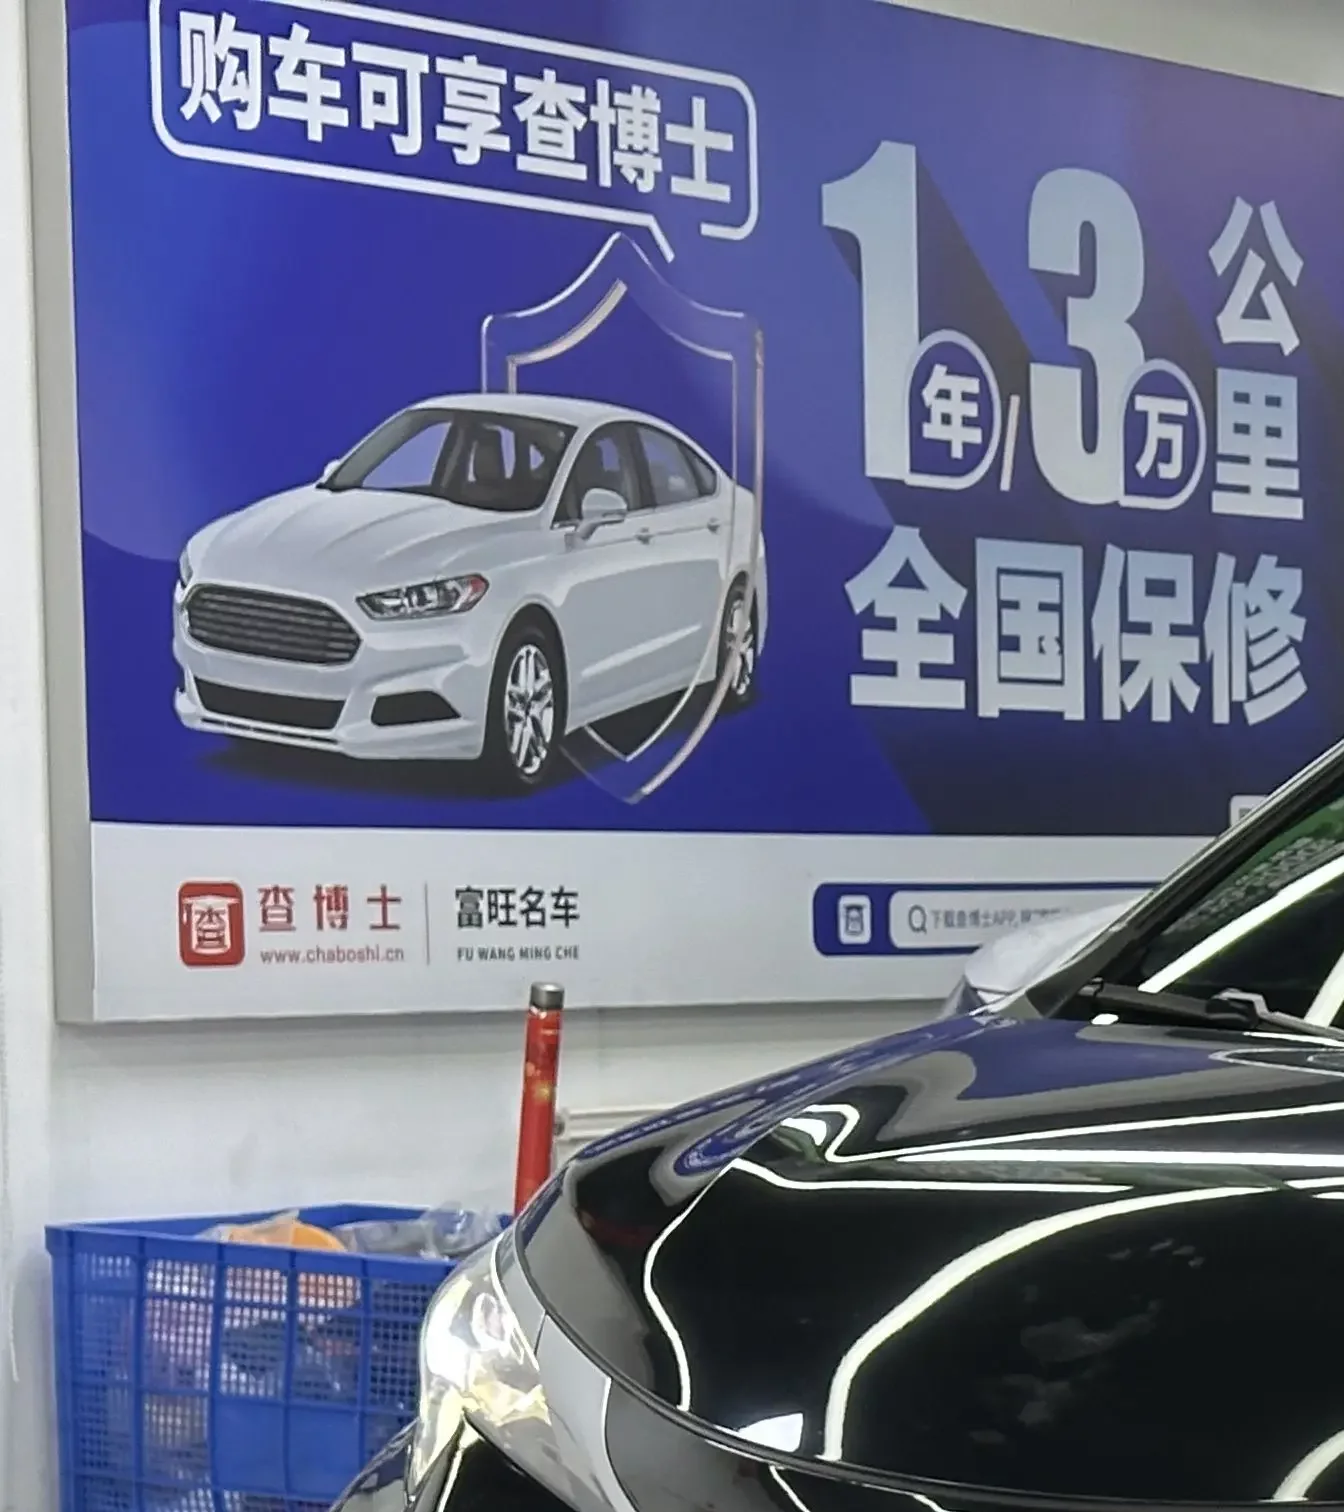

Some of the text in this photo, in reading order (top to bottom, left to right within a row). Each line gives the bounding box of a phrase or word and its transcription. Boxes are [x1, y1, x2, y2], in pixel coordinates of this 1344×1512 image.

[178, 11, 734, 205] 购车可享查博士
[844, 525, 1308, 726] 全国保修
[258, 883, 402, 932] 查博士
[455, 885, 580, 931] 富旺名车
[260, 942, 405, 965] www.chaboshi.cn
